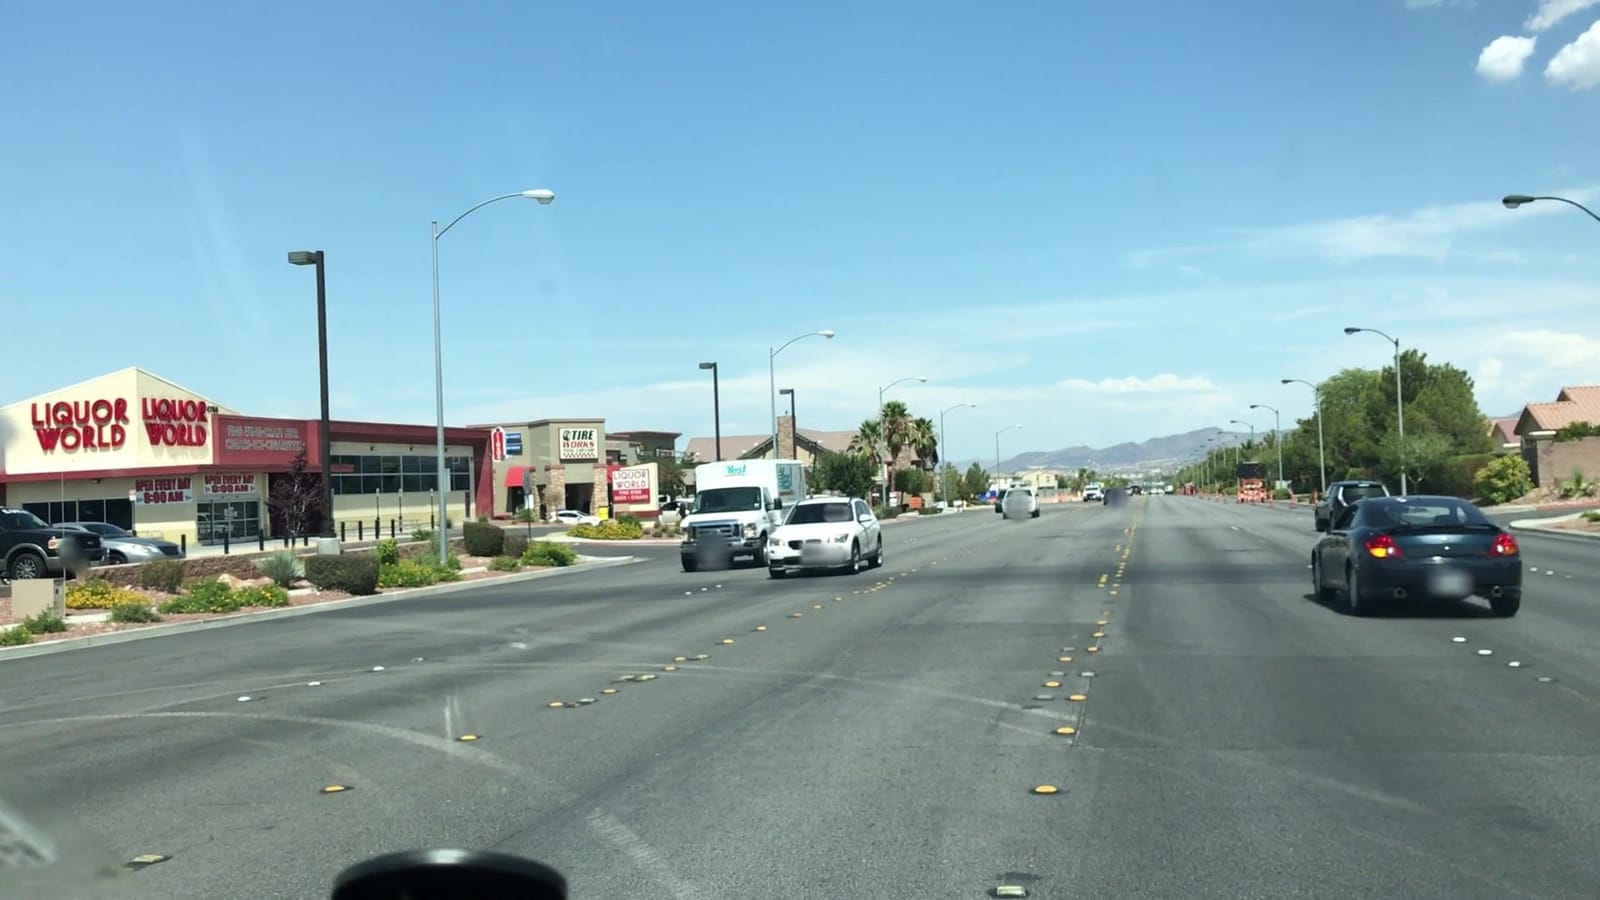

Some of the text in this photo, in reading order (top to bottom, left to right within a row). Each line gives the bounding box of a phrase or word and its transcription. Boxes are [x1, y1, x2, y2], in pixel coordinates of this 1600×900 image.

[31, 398, 129, 427] LIQUOR
[142, 397, 207, 422] LIQUOR
[36, 424, 126, 451] WORLD
[144, 423, 206, 447] WORLD
[572, 430, 595, 440] TIRE
[614, 471, 647, 480] LIQUOR
[726, 464, 746, 476] Yes!
[135, 477, 192, 491] OPEN EVERY DAY
[204, 475, 254, 484] OPEN EVERY DAY
[615, 480, 646, 488] WORLD
[168, 491, 184, 502] AM
